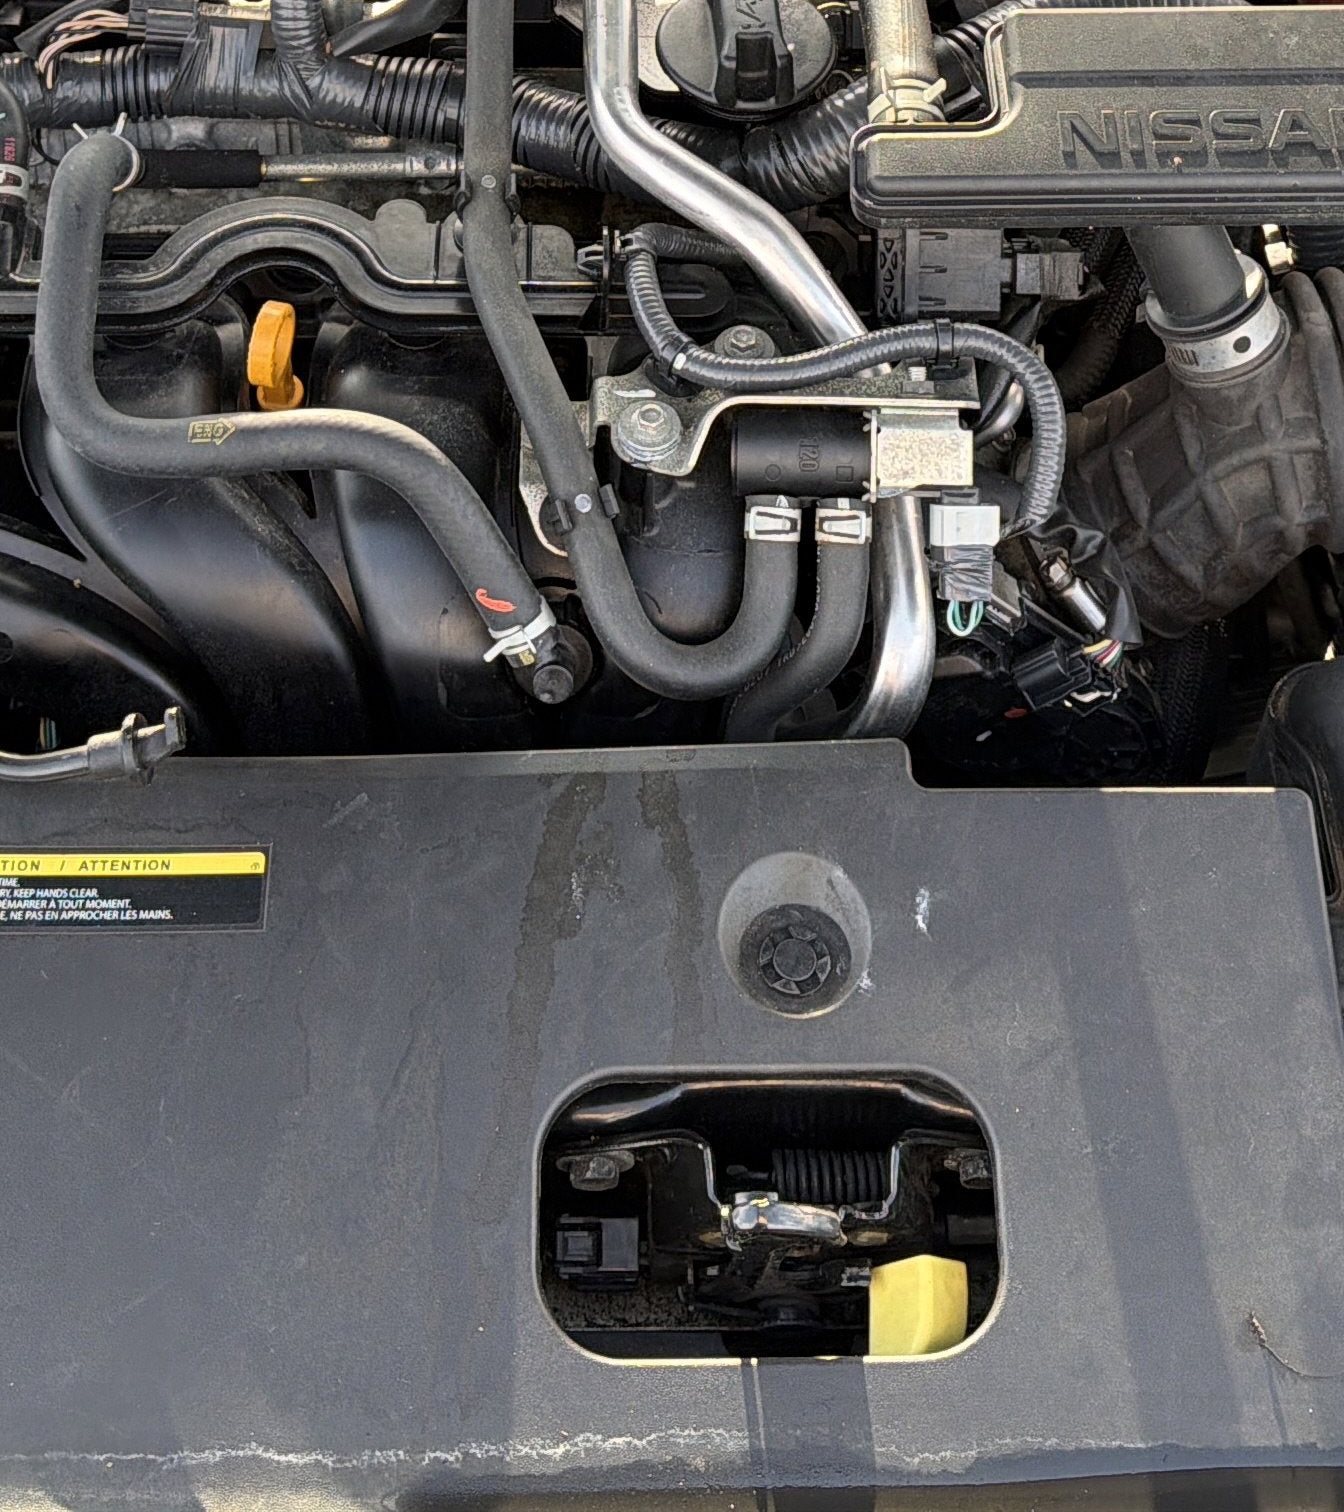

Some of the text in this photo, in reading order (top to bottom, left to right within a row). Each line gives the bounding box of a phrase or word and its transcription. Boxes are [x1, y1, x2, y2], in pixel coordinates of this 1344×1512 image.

[193, 423, 225, 438] ENG
[79, 860, 171, 872] ATTENTION
[13, 888, 35, 898] KEEP
[36, 888, 68, 898] HANDS
[58, 898, 83, 908] TOUT
[85, 898, 131, 908] MOMENT.
[10, 909, 23, 920] NE
[25, 909, 43, 920] PAS
[45, 909, 57, 920] EN
[60, 909, 118, 920] APPROCHER
[120, 909, 137, 920] LES
[139, 909, 173, 920] MAINS.
